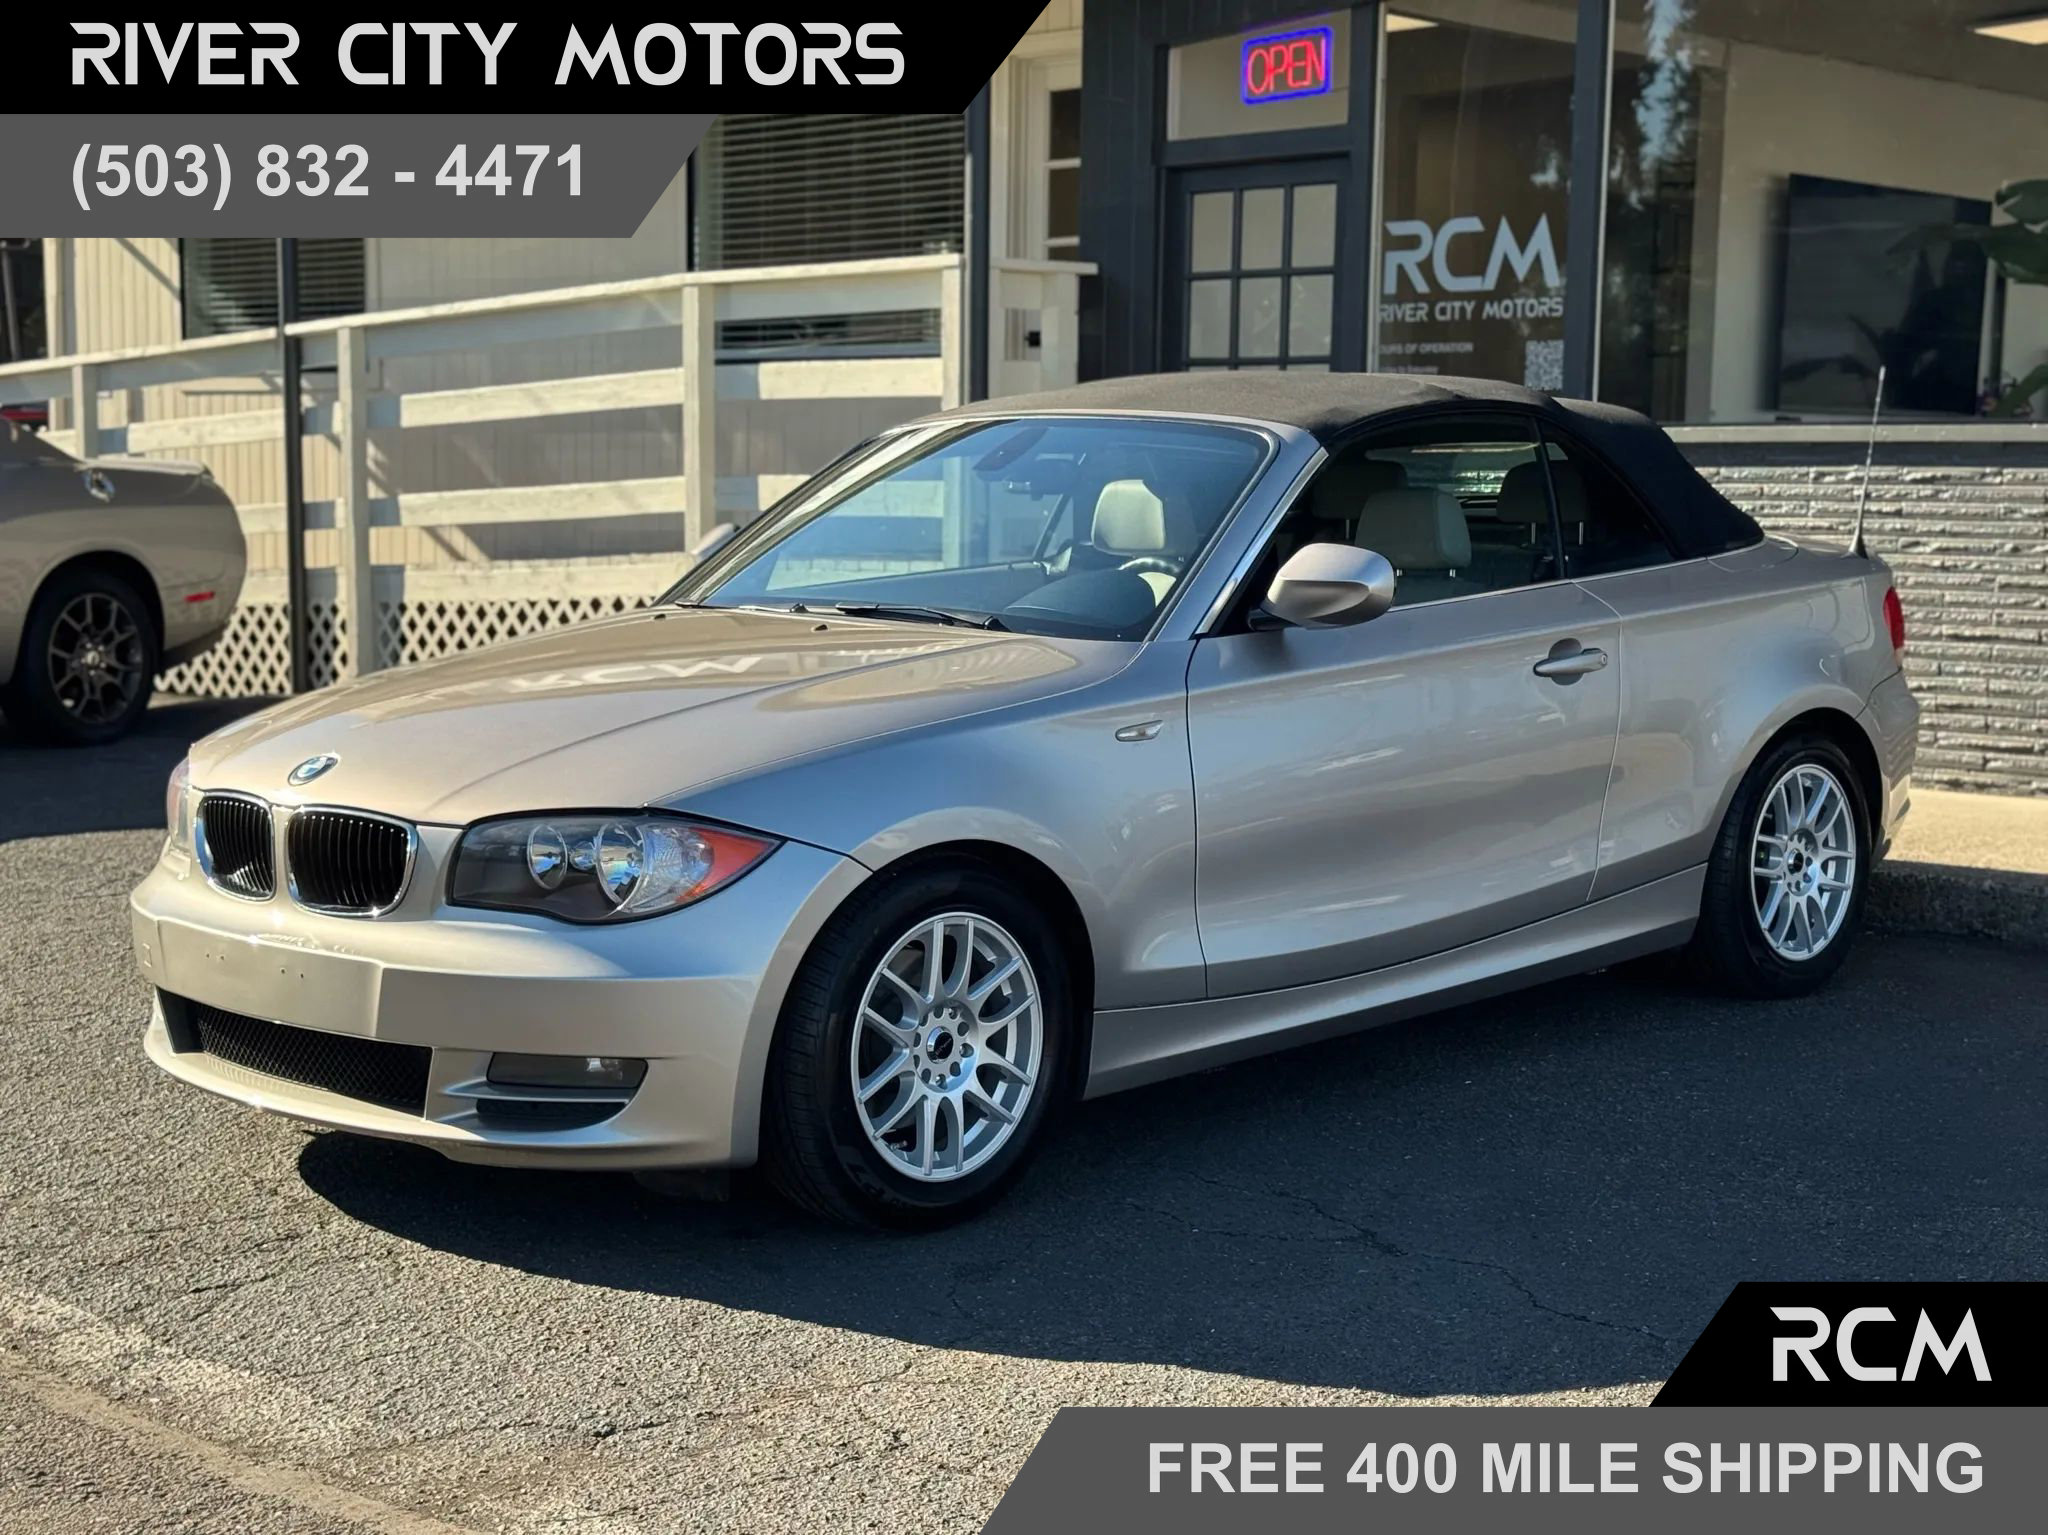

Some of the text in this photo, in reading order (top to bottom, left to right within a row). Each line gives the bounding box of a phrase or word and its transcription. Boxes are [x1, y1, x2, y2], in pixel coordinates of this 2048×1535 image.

[1248, 36, 1326, 94] OPEN
[1384, 213, 1561, 294] RCM
[1379, 297, 1564, 323] RIVER CITY MOTORS
